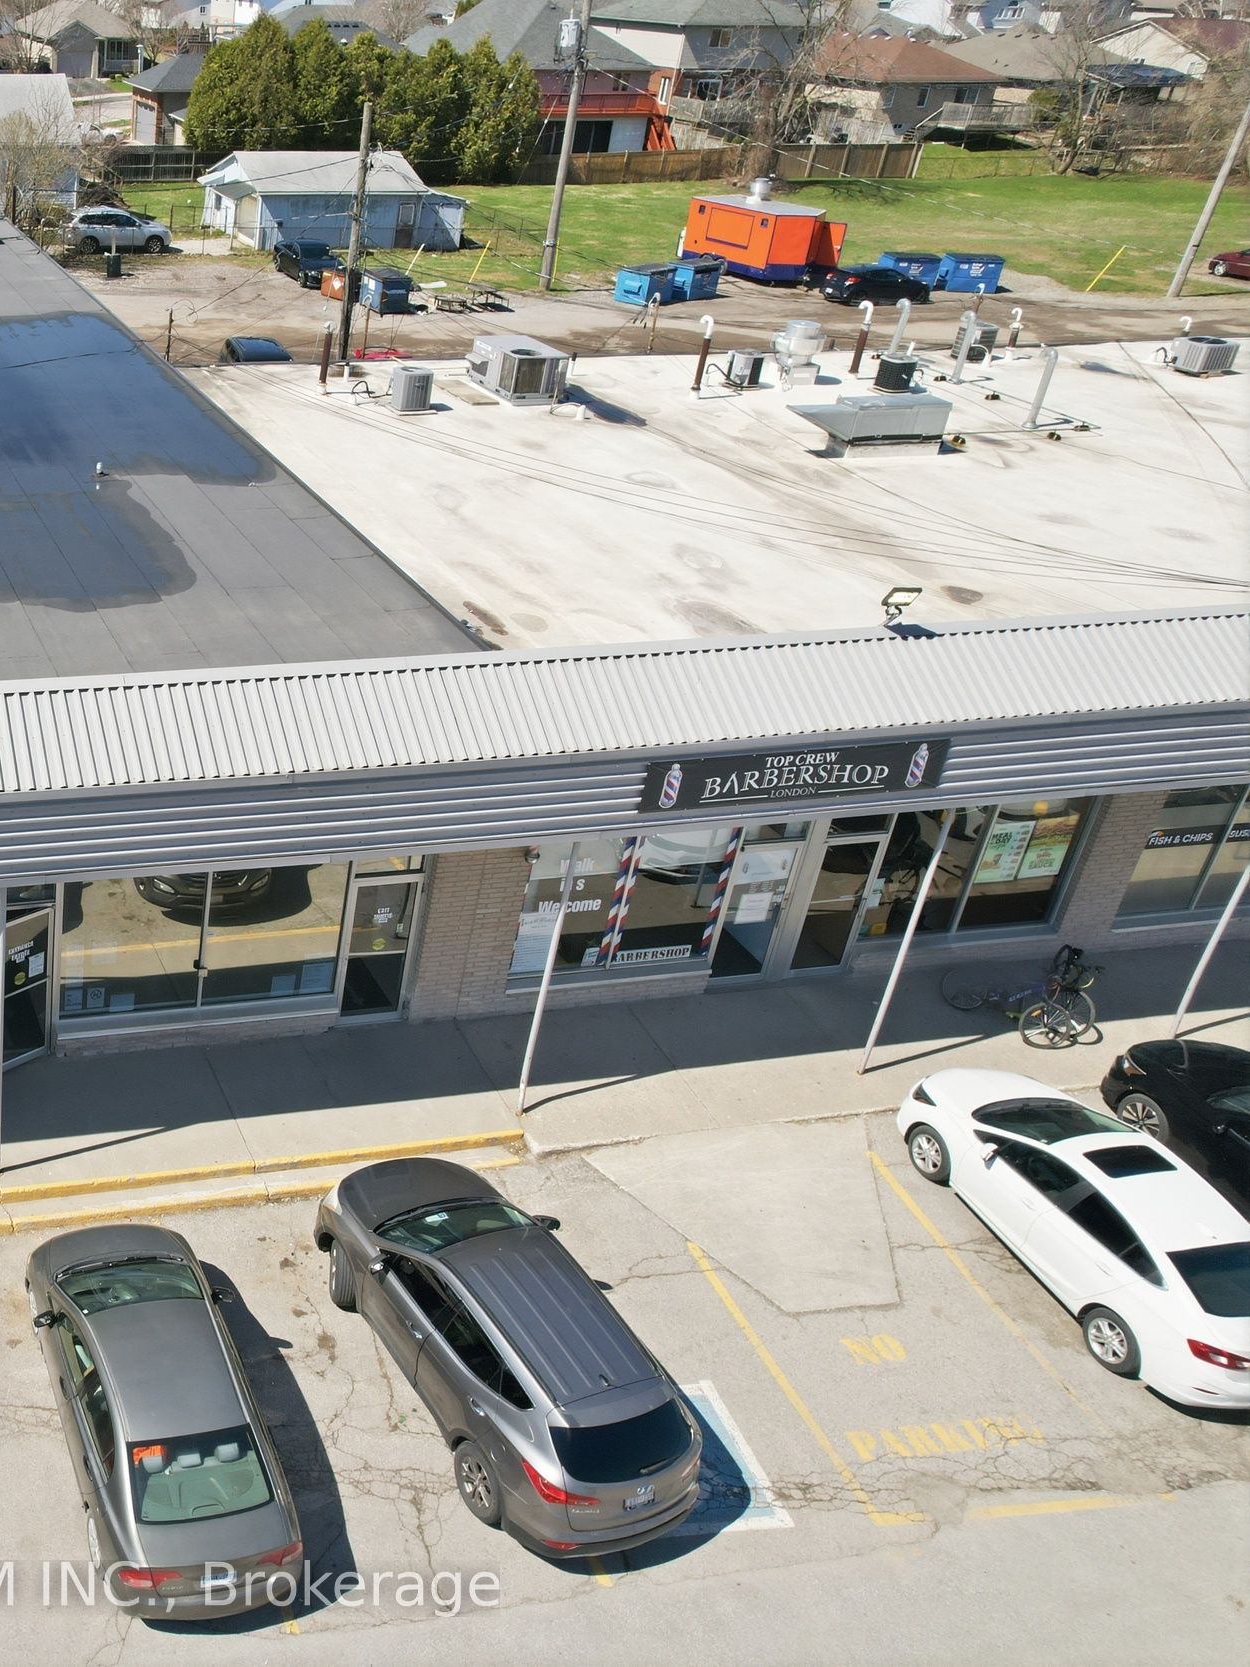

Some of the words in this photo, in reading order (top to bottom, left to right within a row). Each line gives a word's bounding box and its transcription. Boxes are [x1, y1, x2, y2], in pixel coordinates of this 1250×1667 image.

[765, 755, 796, 768] TOP
[795, 751, 840, 766] CREW
[700, 763, 890, 799] BARBERSHOP
[770, 787, 818, 798] LONDON
[1149, 836, 1174, 846] FISH
[1182, 832, 1214, 843] CHIPS
[539, 899, 602, 914] Wecome
[838, 1333, 908, 1367] NO
